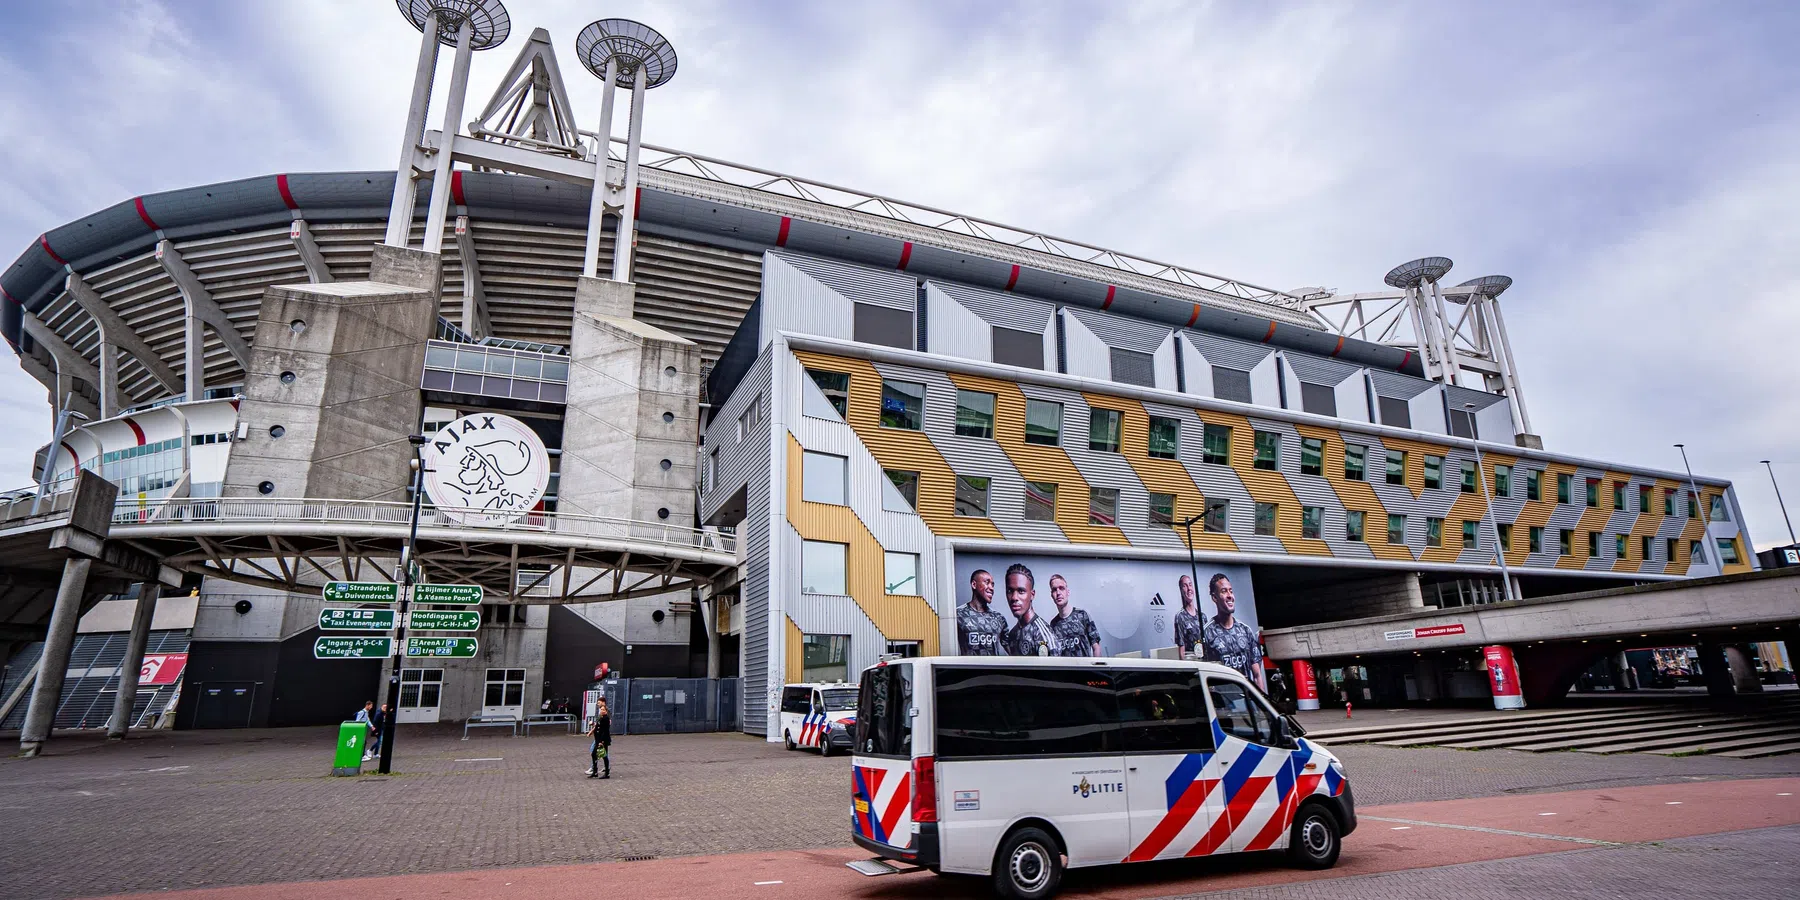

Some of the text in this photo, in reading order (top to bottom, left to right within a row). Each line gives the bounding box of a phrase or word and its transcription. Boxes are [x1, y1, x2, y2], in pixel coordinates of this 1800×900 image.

[434, 416, 496, 455] AJAX
[349, 584, 390, 592] Strandvliet
[425, 586, 451, 594] Bijlmer
[411, 620, 435, 628] Ingang
[327, 639, 354, 647] Ingang
[1073, 782, 1123, 798] POLITIE
